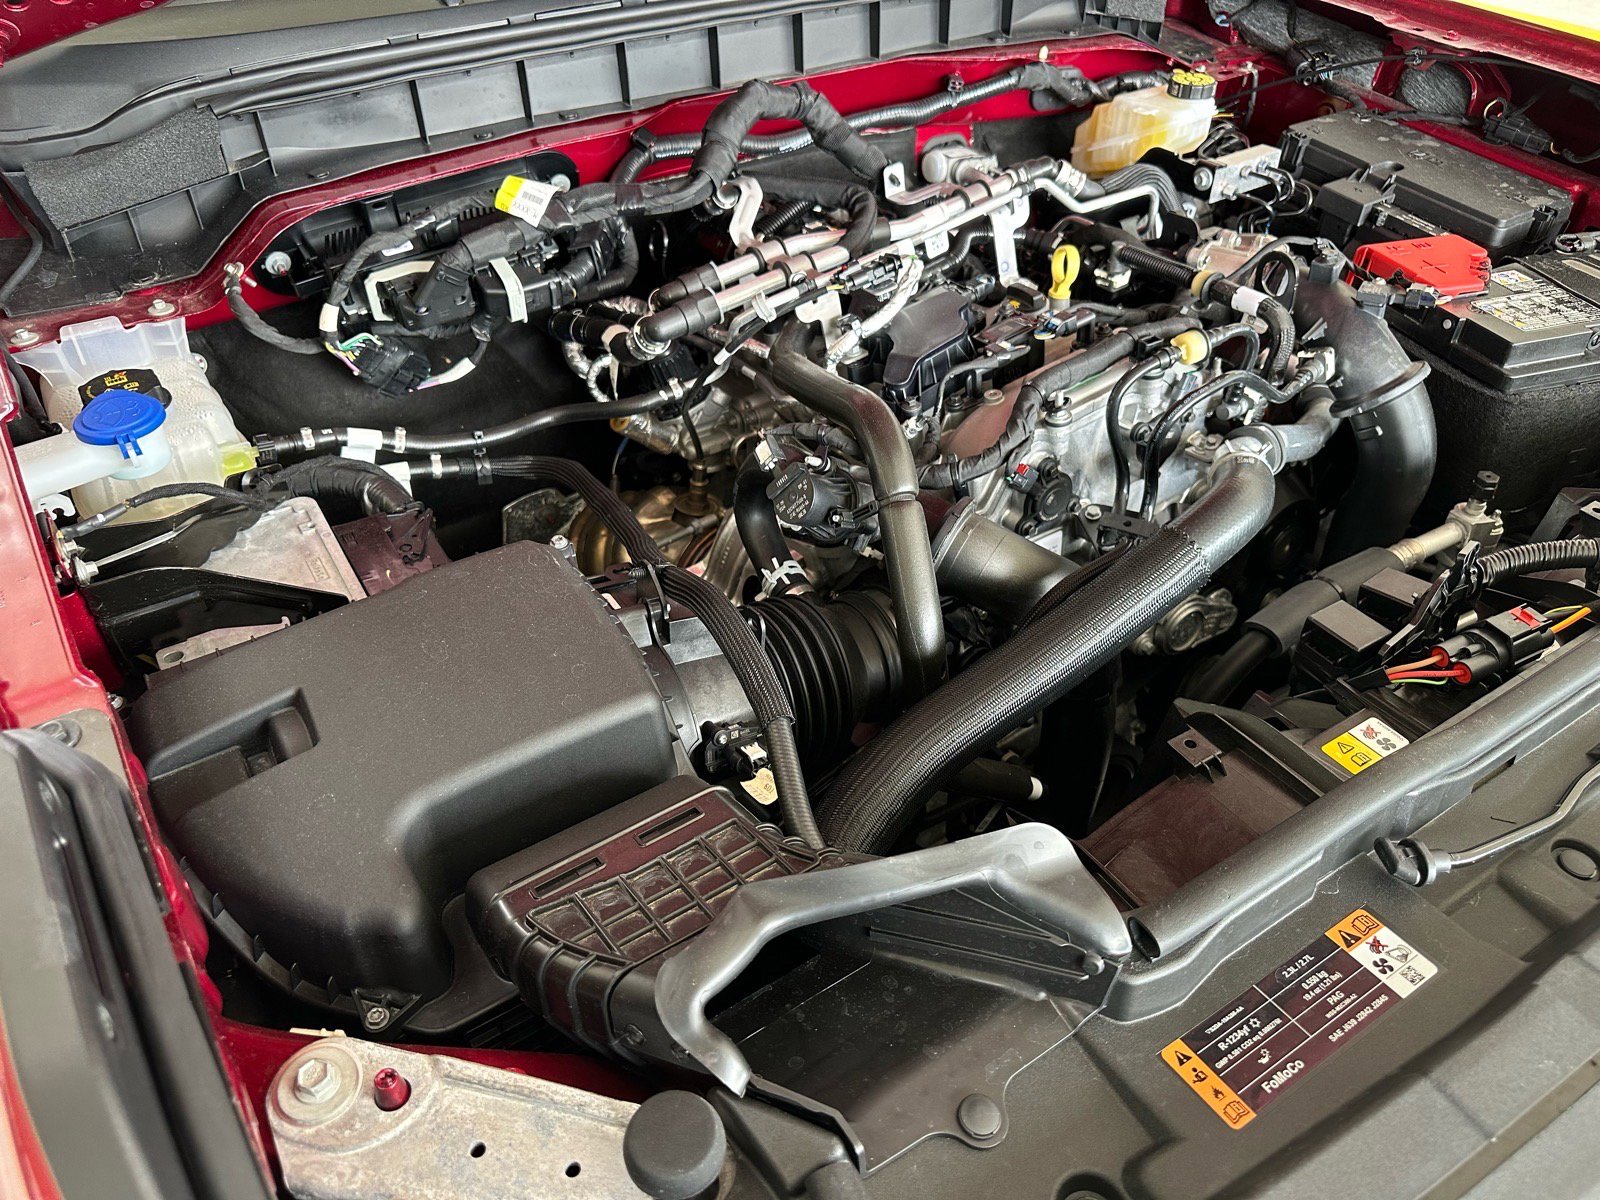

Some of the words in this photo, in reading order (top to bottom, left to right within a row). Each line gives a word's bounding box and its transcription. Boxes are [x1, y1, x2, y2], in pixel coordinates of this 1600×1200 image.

[1282, 964, 1298, 978] 2.3L
[1298, 954, 1315, 967] 2.7L
[1301, 975, 1320, 990] 0.550
[1315, 970, 1329, 979] kg
[1326, 991, 1345, 1005] PAG
[1328, 1028, 1345, 1042] SAE
[1342, 1018, 1358, 1032] J639
[1355, 1006, 1374, 1022] J2842
[1371, 994, 1389, 1009] J2845
[1217, 1024, 1251, 1051] R-1234yf
[1214, 1056, 1229, 1069] GWP
[1240, 1038, 1255, 1049] CO2
[1261, 1060, 1305, 1094] FoMoCo
